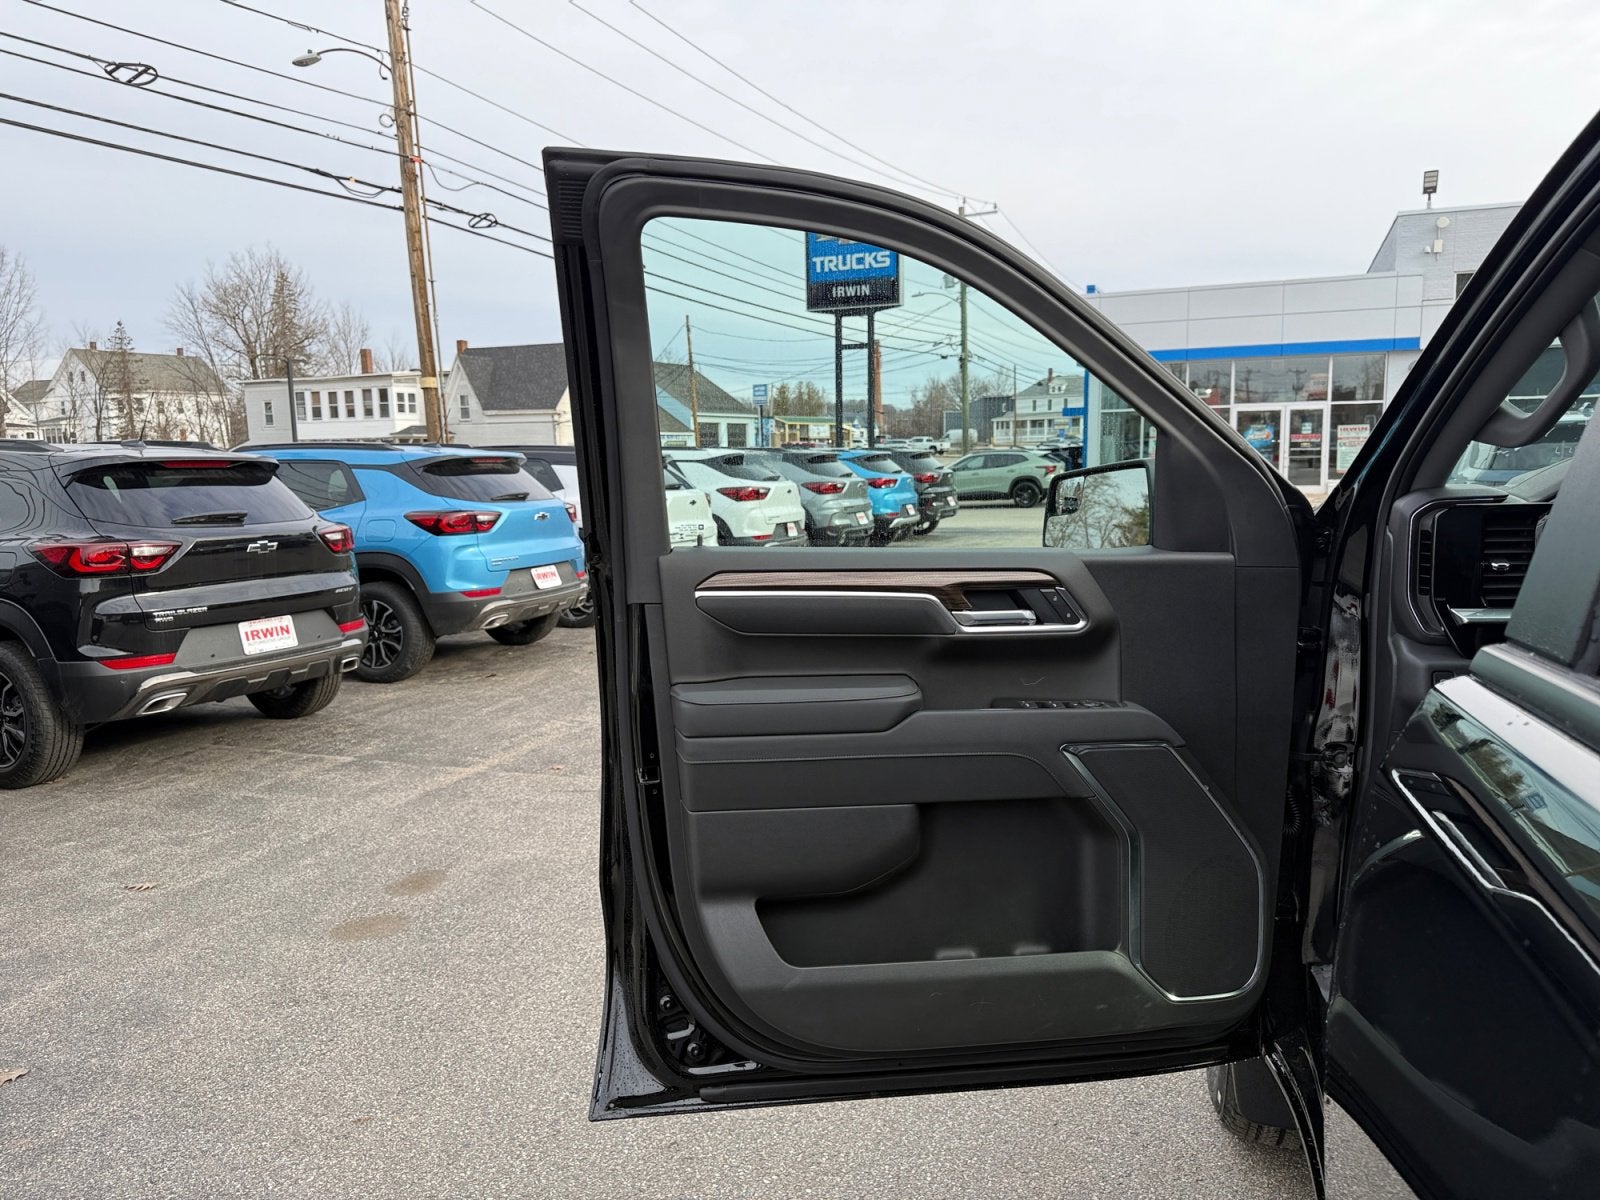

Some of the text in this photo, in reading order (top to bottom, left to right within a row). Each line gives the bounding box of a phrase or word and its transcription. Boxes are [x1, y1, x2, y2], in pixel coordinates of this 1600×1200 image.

[812, 251, 891, 273] TRUCKS
[832, 284, 870, 297] IRWIN
[244, 624, 291, 642] IRWIN
